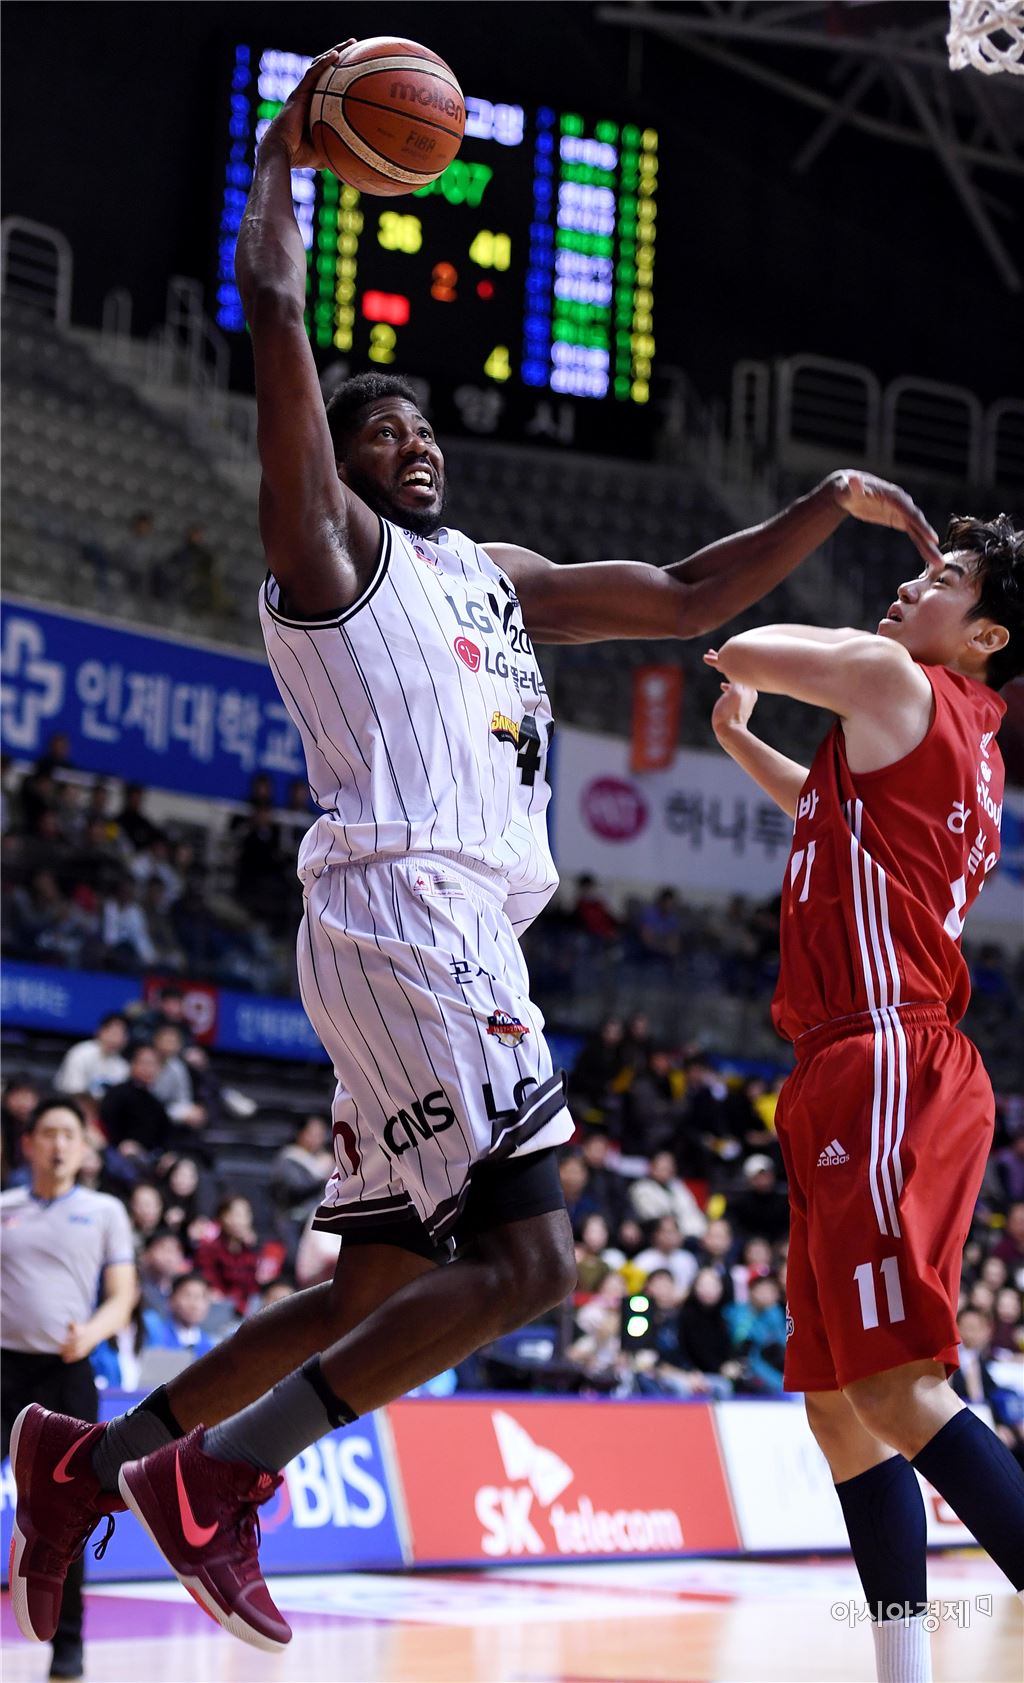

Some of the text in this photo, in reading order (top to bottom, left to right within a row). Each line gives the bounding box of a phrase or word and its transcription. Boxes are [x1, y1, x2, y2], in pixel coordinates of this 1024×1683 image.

[390, 82, 463, 123] molten
[405, 129, 437, 154] FIBA
[445, 595, 495, 633] LG
[76, 659, 303, 773] 인제대학교
[383, 1090, 455, 1156] CNS
[816, 1154, 850, 1167] adidas
[853, 1256, 906, 1331] 11
[474, 1486, 684, 1556] SK telecom
